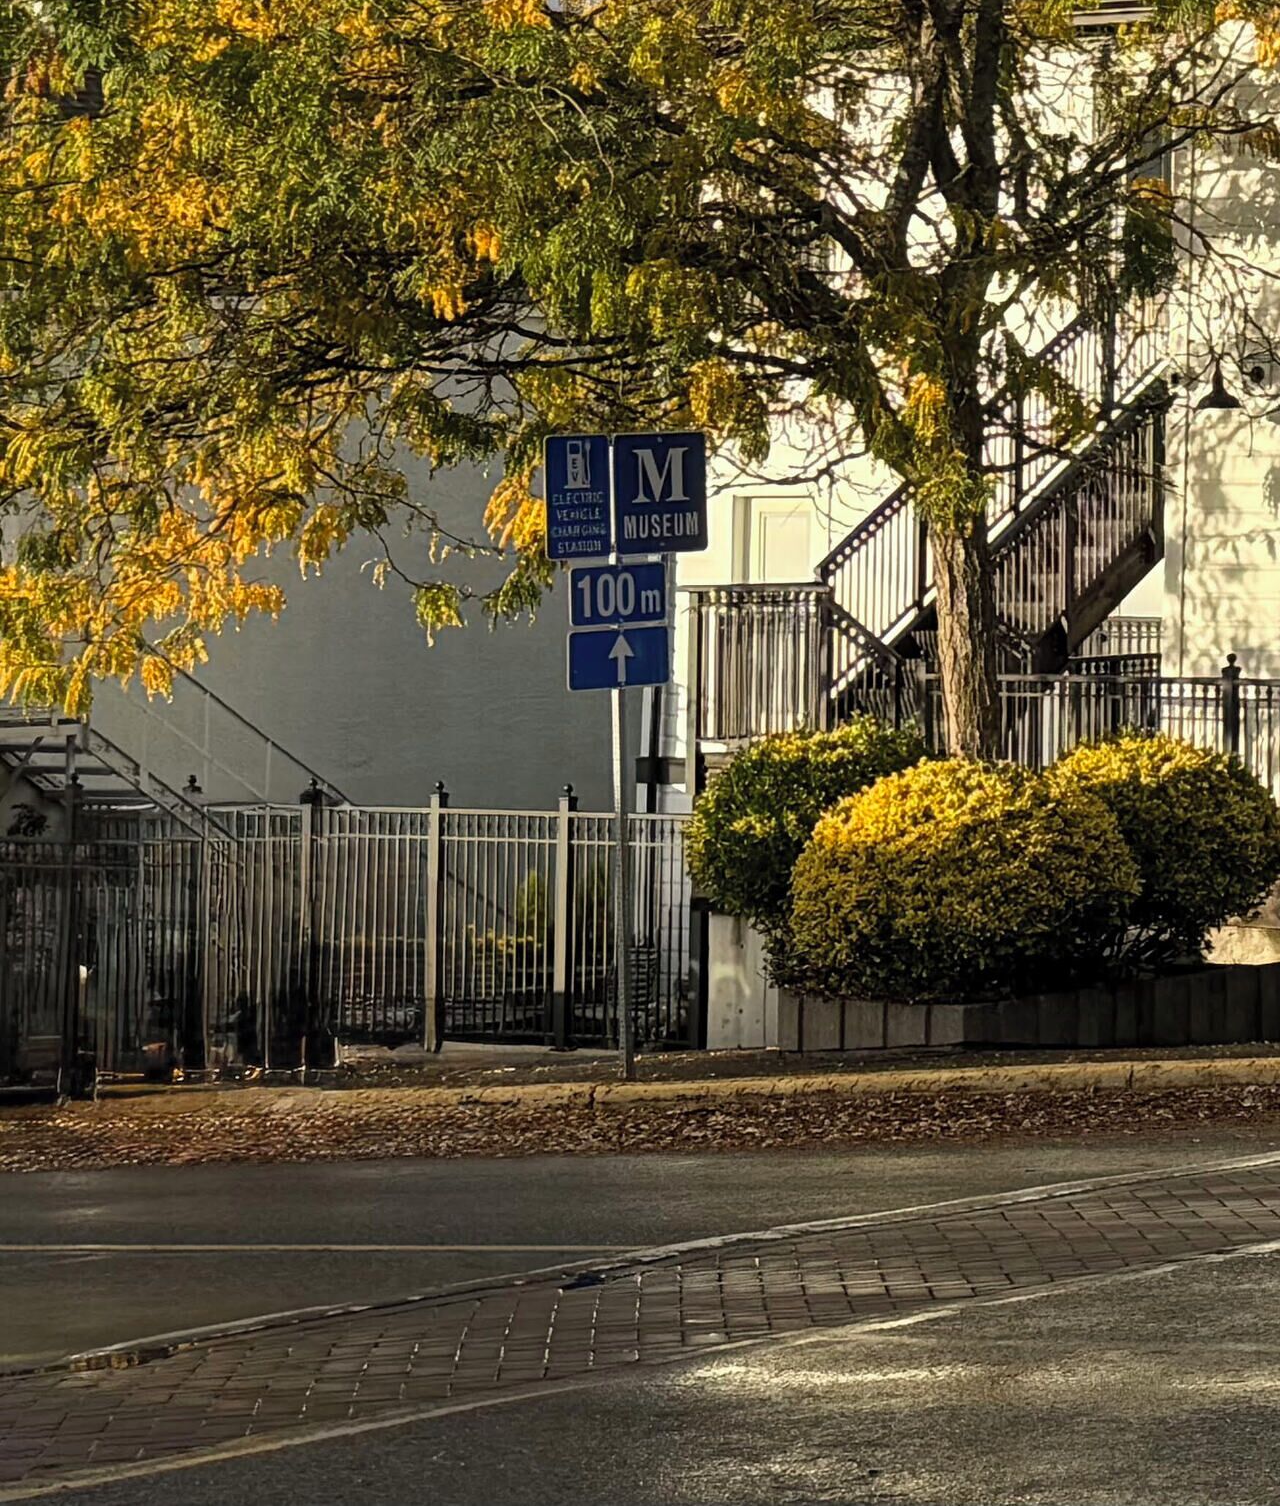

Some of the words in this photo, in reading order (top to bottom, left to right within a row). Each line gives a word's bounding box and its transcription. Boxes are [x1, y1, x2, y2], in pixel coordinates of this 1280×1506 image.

[631, 447, 690, 504] M
[552, 491, 604, 505] ELECTRIC
[623, 511, 700, 540] MUSEUM
[558, 539, 602, 554] STATION
[577, 572, 635, 618] 100
[640, 589, 661, 615] m
